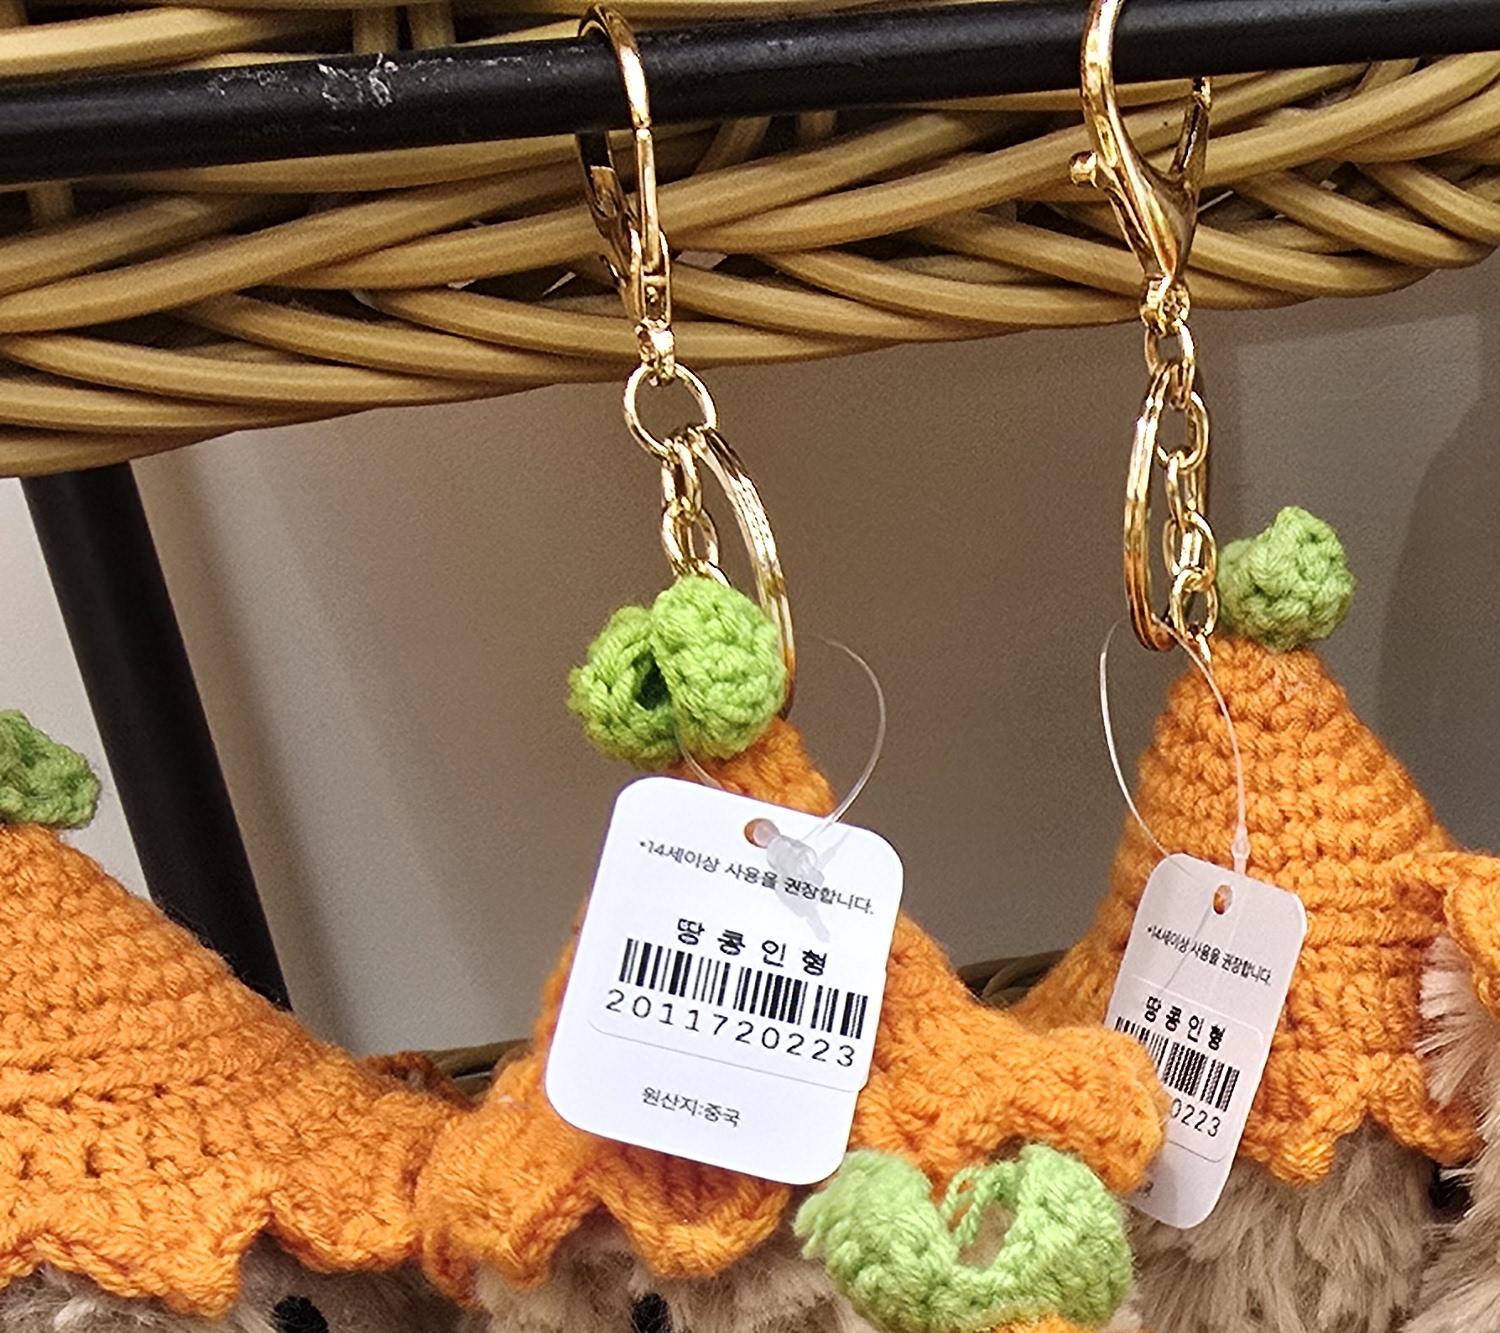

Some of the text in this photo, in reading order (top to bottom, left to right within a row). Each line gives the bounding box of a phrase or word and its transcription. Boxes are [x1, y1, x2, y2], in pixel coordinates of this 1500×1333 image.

[725, 860, 778, 890] 사용을
[784, 875, 875, 915] 권장합니다.
[604, 989, 856, 1069] 2011720223
[1169, 1097, 1222, 1138] 0223
